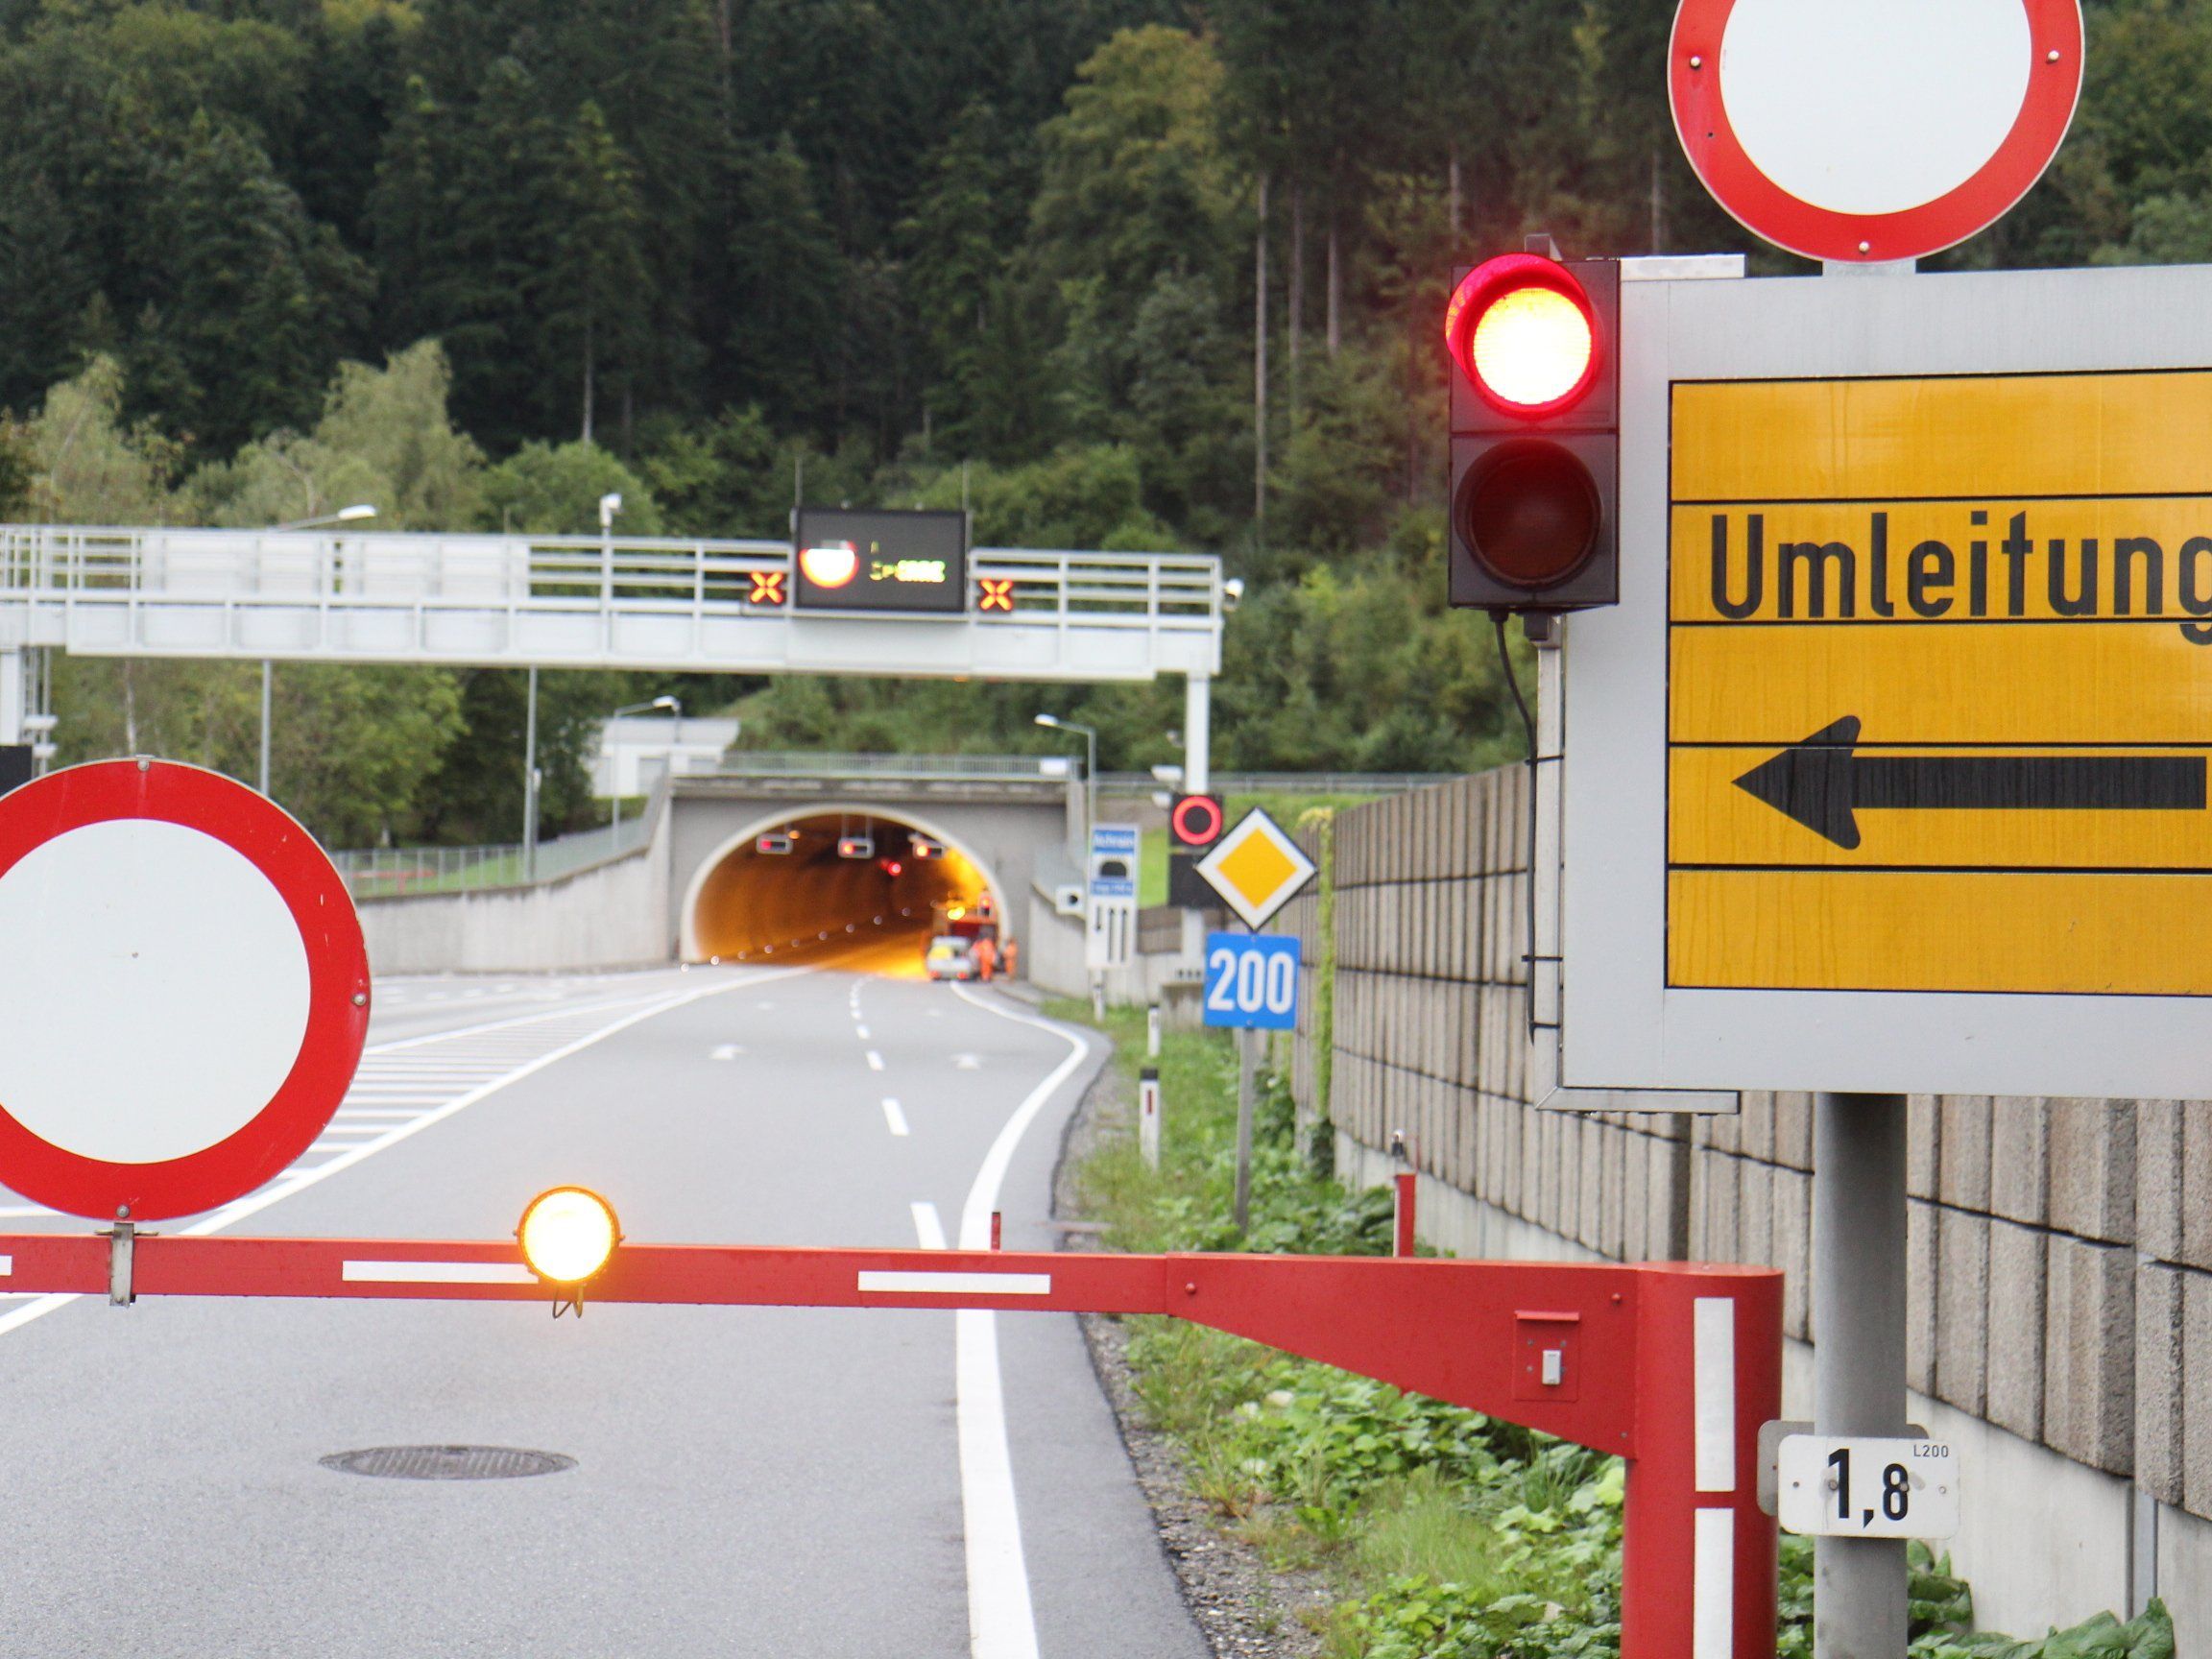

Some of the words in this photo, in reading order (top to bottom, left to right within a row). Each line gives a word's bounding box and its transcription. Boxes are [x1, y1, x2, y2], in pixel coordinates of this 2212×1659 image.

[1712, 510, 2212, 645] Umleitung
[1207, 948, 1294, 1015] 200
[1913, 1444, 1949, 1457] L200
[1828, 1448, 1909, 1528] 1,8
